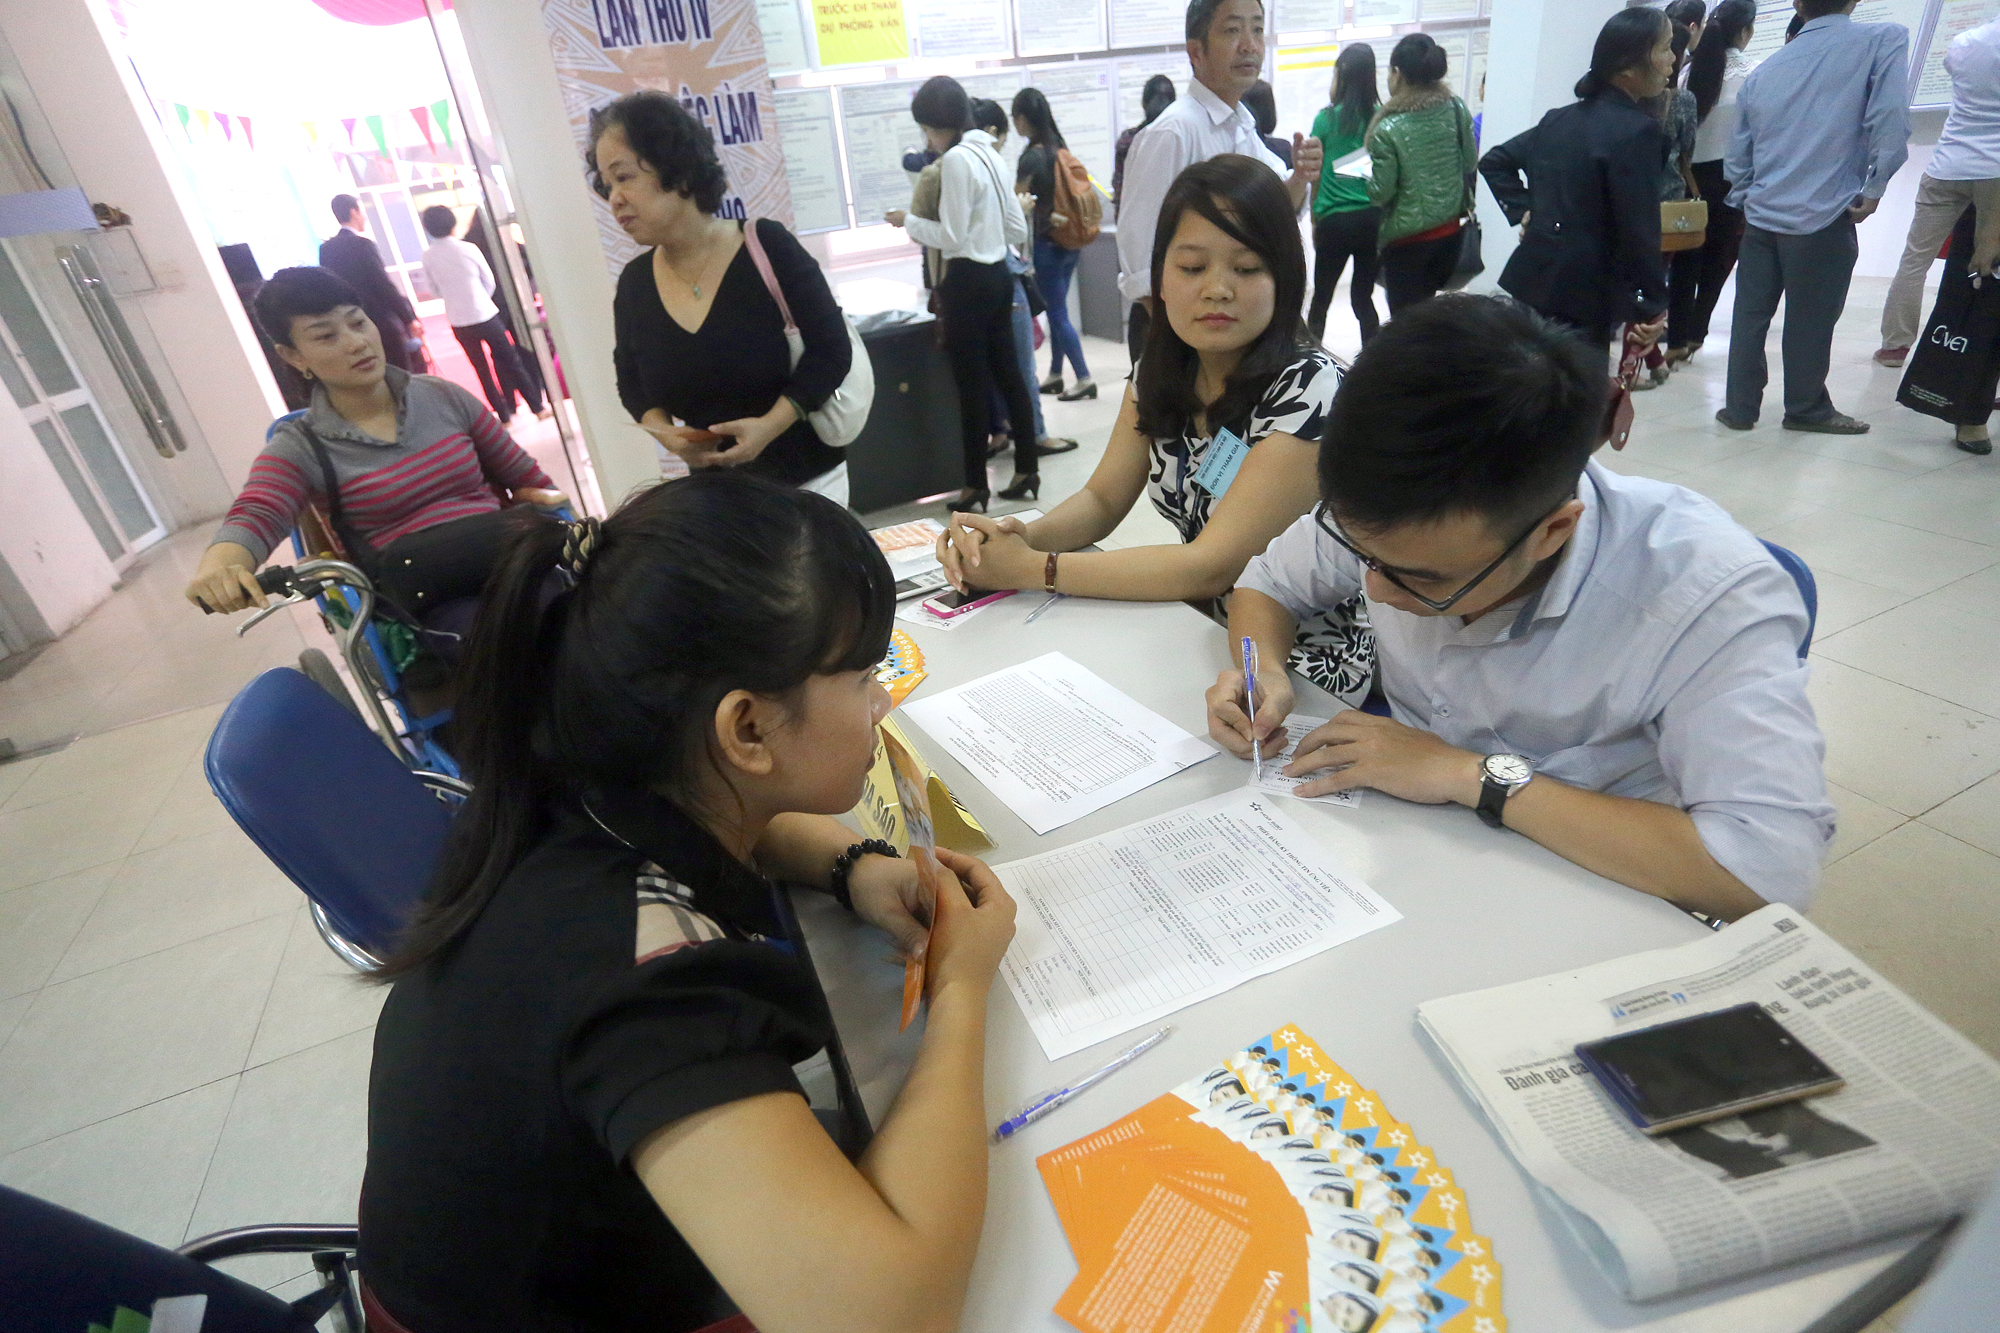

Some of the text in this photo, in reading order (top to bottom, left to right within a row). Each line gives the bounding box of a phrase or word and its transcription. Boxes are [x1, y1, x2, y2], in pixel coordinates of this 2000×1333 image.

[713, 81, 762, 145] LÀM
[1208, 442, 1240, 490] ĐƠN VỊ THAM GIA
[872, 795, 896, 841] SAO
[1503, 1067, 1546, 1092] Đánh
[1543, 1062, 1570, 1086] giá
